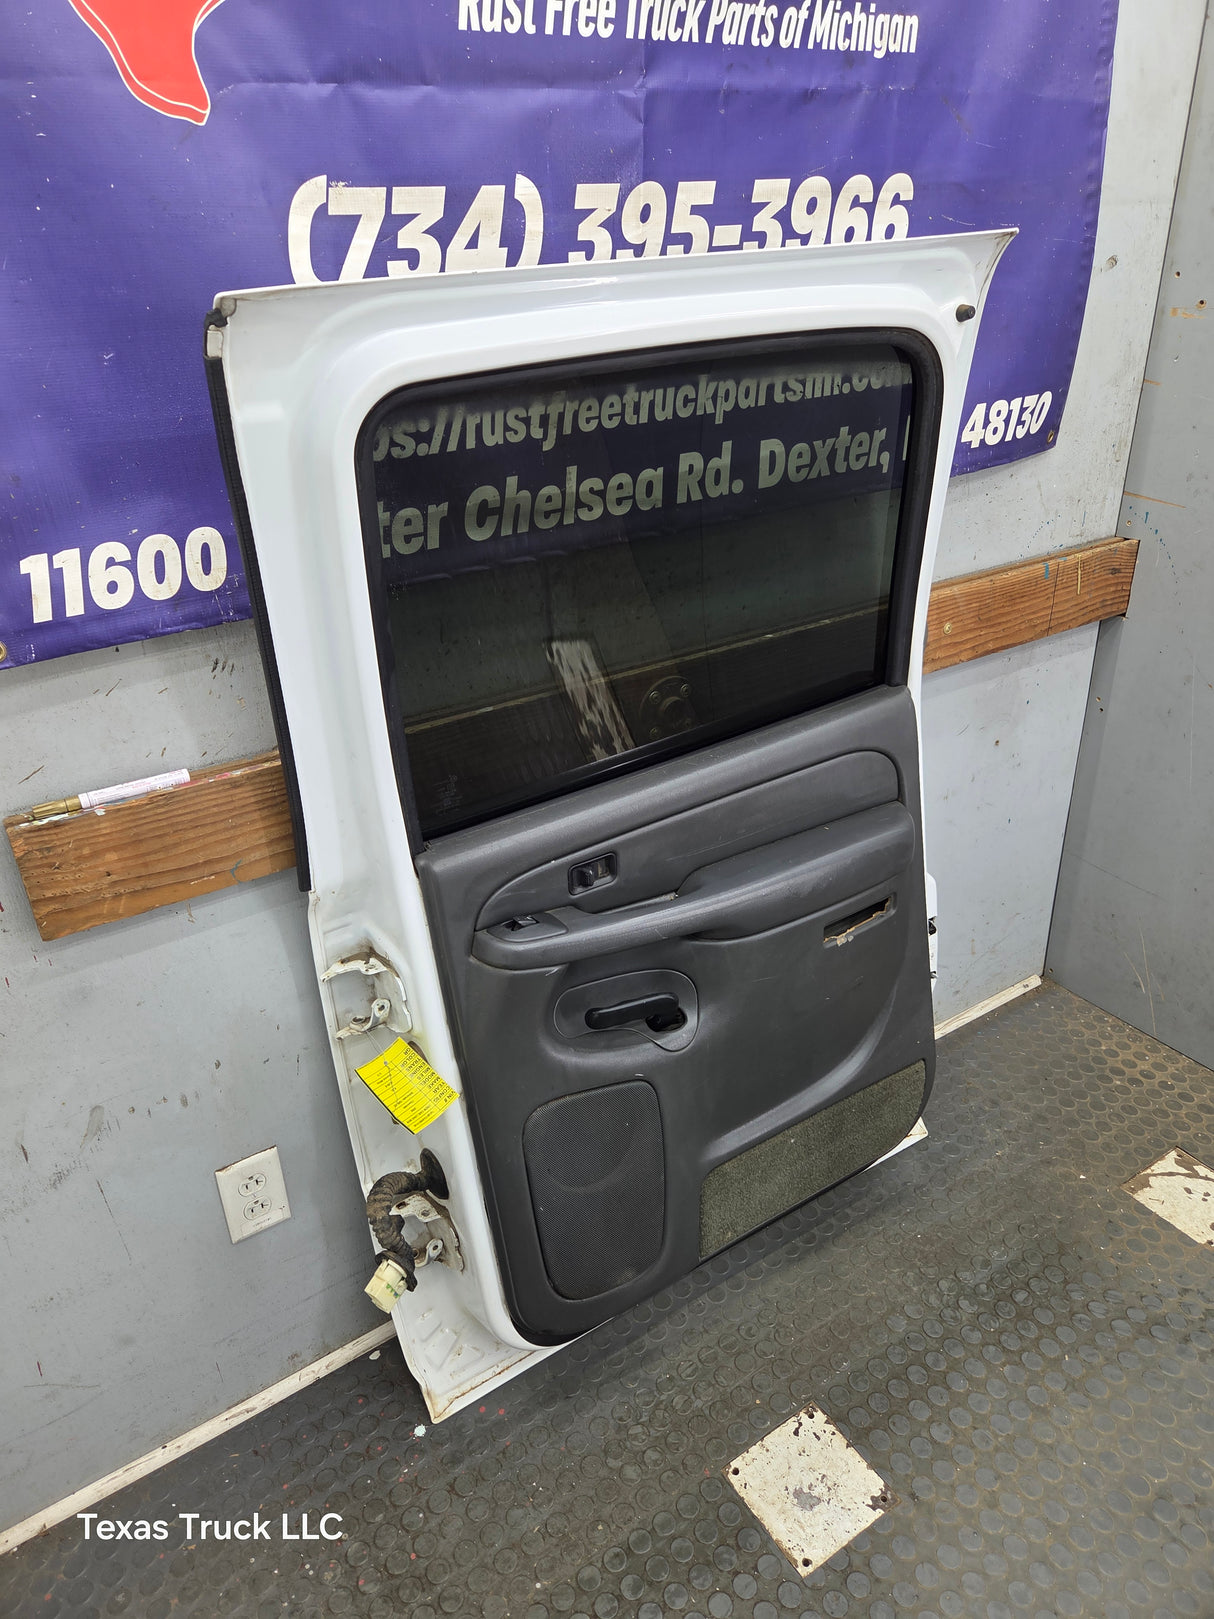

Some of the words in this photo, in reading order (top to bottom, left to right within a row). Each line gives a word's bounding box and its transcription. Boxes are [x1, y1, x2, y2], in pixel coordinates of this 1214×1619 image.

[458, 0, 536, 34] Rust
[545, 0, 616, 39] Free
[626, 0, 699, 43] Truck
[705, 0, 778, 48] Parts
[779, 0, 810, 49] of
[808, 0, 919, 59] Michigan
[287, 173, 544, 285] (734)
[568, 172, 914, 264] 395-3966
[19, 526, 228, 624] 11600
[464, 465, 663, 542] Chelsea
[676, 440, 744, 502] Rd.
[758, 425, 890, 489] Dexter,
[961, 391, 1052, 449] 48130
